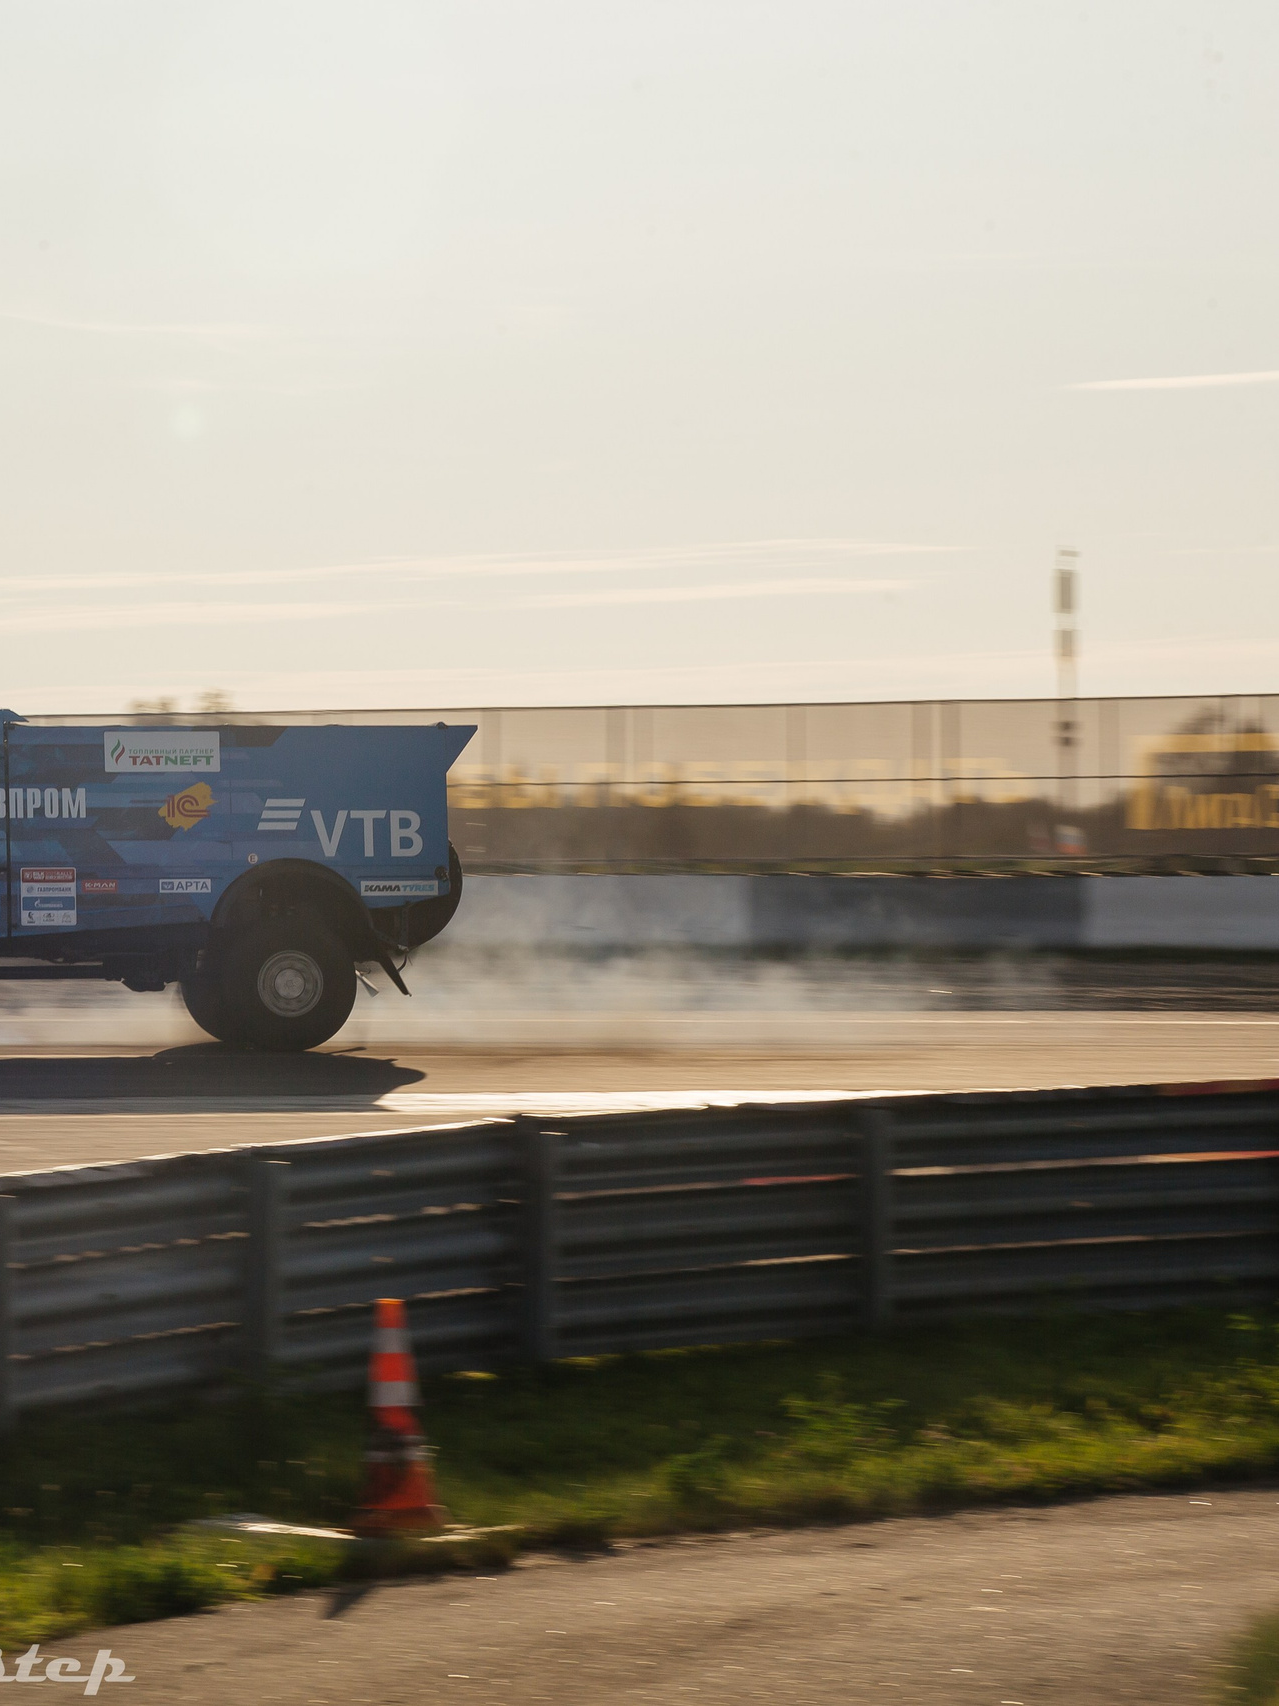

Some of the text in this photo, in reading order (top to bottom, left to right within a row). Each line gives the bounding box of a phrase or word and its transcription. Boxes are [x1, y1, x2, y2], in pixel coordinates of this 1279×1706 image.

[128, 755, 214, 766] TATNEFT
[310, 809, 424, 858] VTB
[364, 884, 401, 893] KAMA
